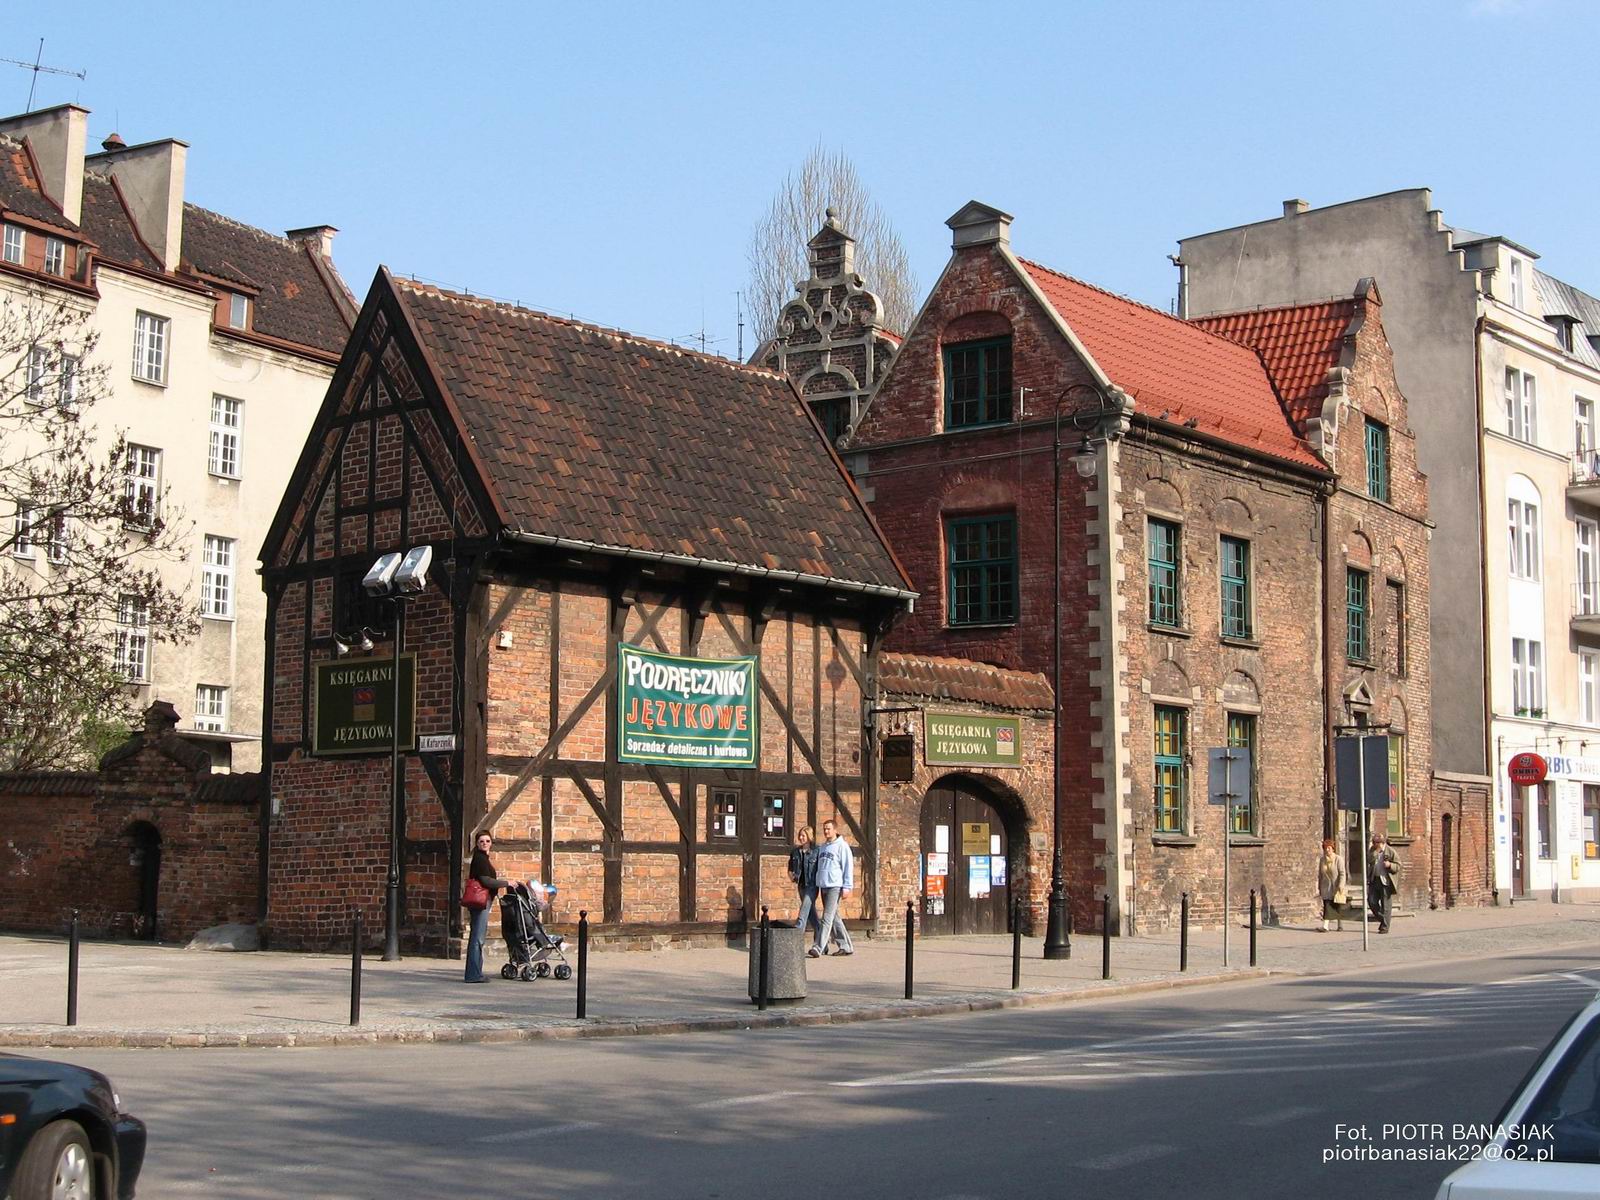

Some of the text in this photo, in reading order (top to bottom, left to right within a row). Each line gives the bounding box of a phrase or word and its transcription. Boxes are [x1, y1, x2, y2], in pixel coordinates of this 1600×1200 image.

[330, 667, 392, 686] KSIĘGARNI
[626, 655, 746, 699] PODRĘCZNIKI
[626, 697, 748, 730] JĘZYKOWE
[333, 725, 393, 743] JĘZYKOWA
[931, 723, 991, 738] KSIĘGARNIA
[627, 738, 748, 758] Sprzedaż detaliczna i hurtowa
[936, 741, 988, 755] JĘZYKOWA
[1545, 756, 1572, 775] RBIS
